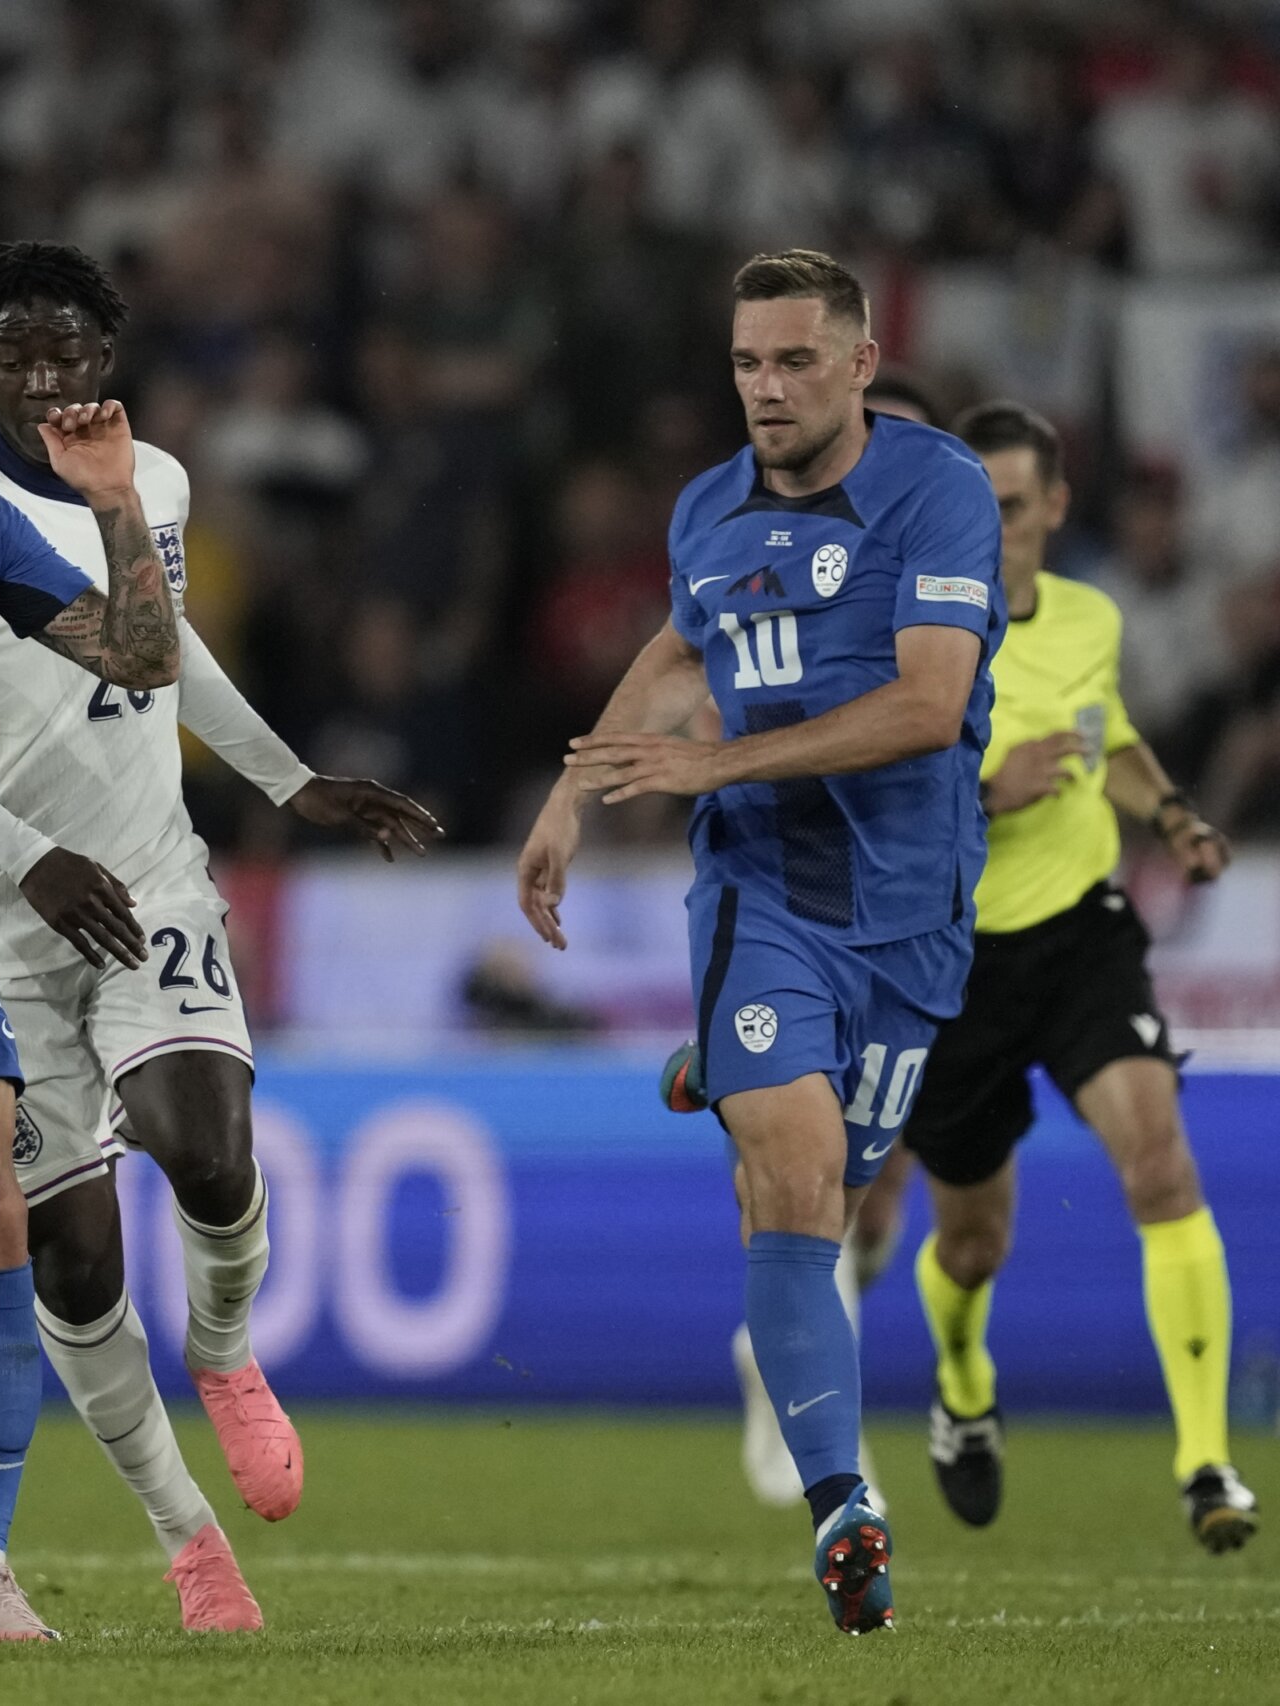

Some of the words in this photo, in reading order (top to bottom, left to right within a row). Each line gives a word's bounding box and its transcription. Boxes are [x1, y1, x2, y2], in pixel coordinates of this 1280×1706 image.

[719, 610, 803, 689] 10
[151, 927, 233, 1001] 26
[844, 1043, 928, 1129] 10
